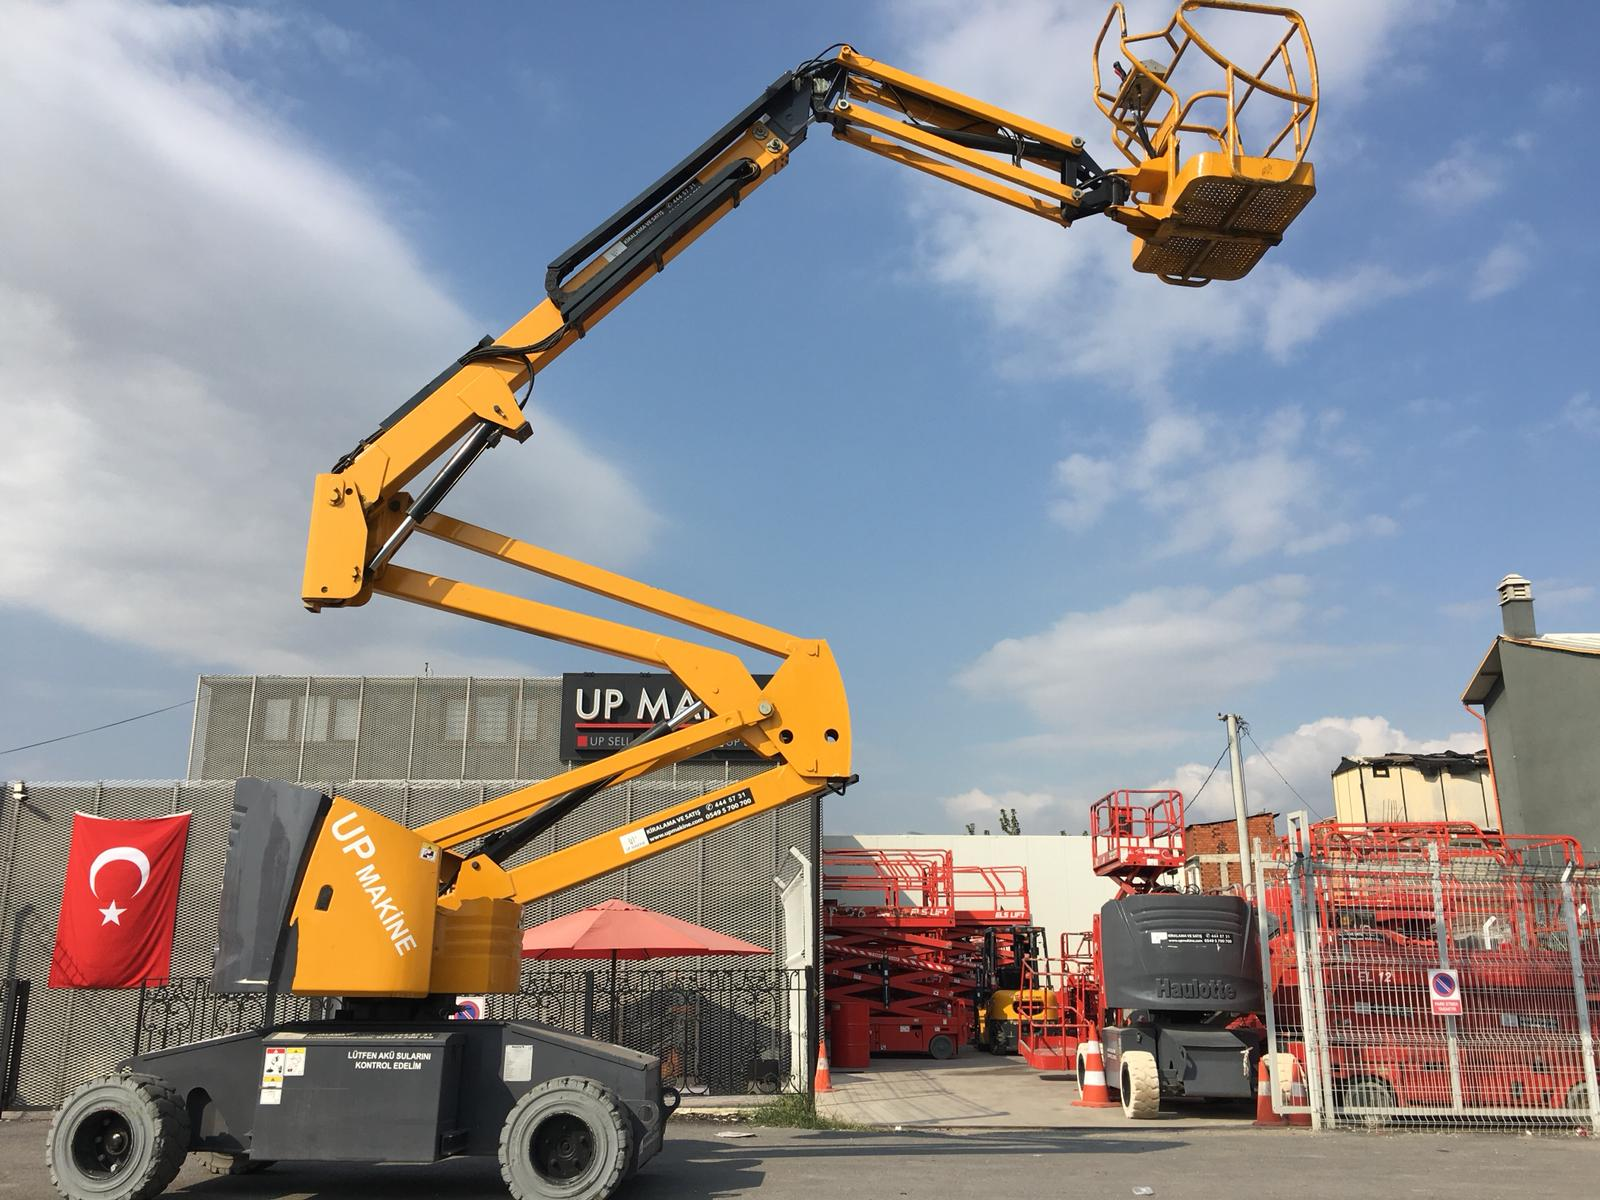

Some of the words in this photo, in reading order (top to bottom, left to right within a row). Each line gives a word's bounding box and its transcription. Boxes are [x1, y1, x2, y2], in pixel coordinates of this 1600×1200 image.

[576, 688, 624, 721] UP
[590, 736, 605, 746] UP
[705, 809, 721, 820] 0549
[721, 806, 727, 814] 5
[727, 803, 739, 812] 700
[739, 798, 752, 807] 700
[714, 799, 727, 808] 444
[738, 791, 746, 799] 31
[646, 819, 677, 835] KİRALAMA
[677, 815, 685, 823] VE
[685, 809, 701, 821] SATIŞ
[331, 811, 377, 859] UP
[355, 863, 418, 956] MAKİNE
[1378, 971, 1392, 983] 12
[1156, 977, 1237, 1000] Haulotte
[348, 1050, 377, 1060] LÜTFEN
[377, 1050, 395, 1060] AKÜ
[395, 1051, 432, 1061] SULARINI
[355, 1061, 392, 1070] KONTROL
[393, 1061, 422, 1070] EDELİM
